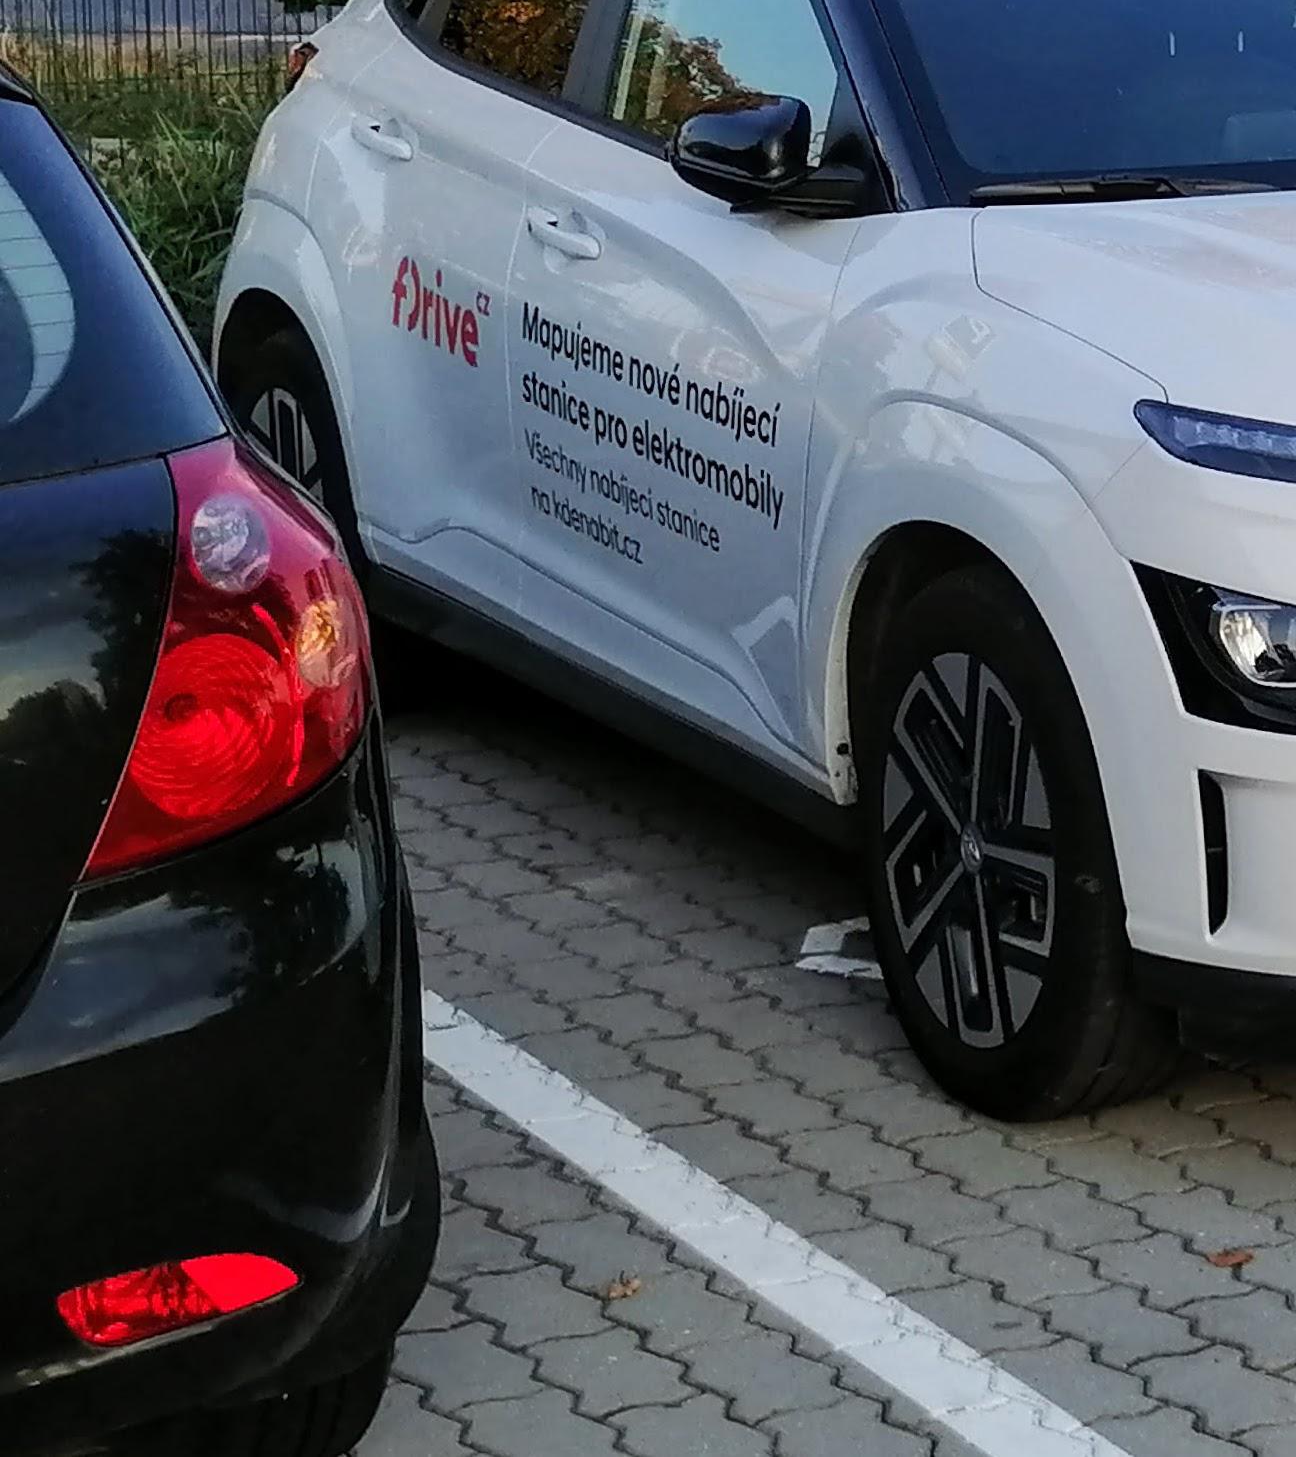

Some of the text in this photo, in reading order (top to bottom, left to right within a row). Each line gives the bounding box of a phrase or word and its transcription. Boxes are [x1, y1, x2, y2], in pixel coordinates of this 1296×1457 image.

[521, 301, 782, 448] Mapujeme nové nabíjecí
[522, 370, 784, 531] stanice pro elektromobily
[524, 427, 721, 553] Všechny nabíjecí stanice
[531, 484, 645, 565] na kdenabit.cz
